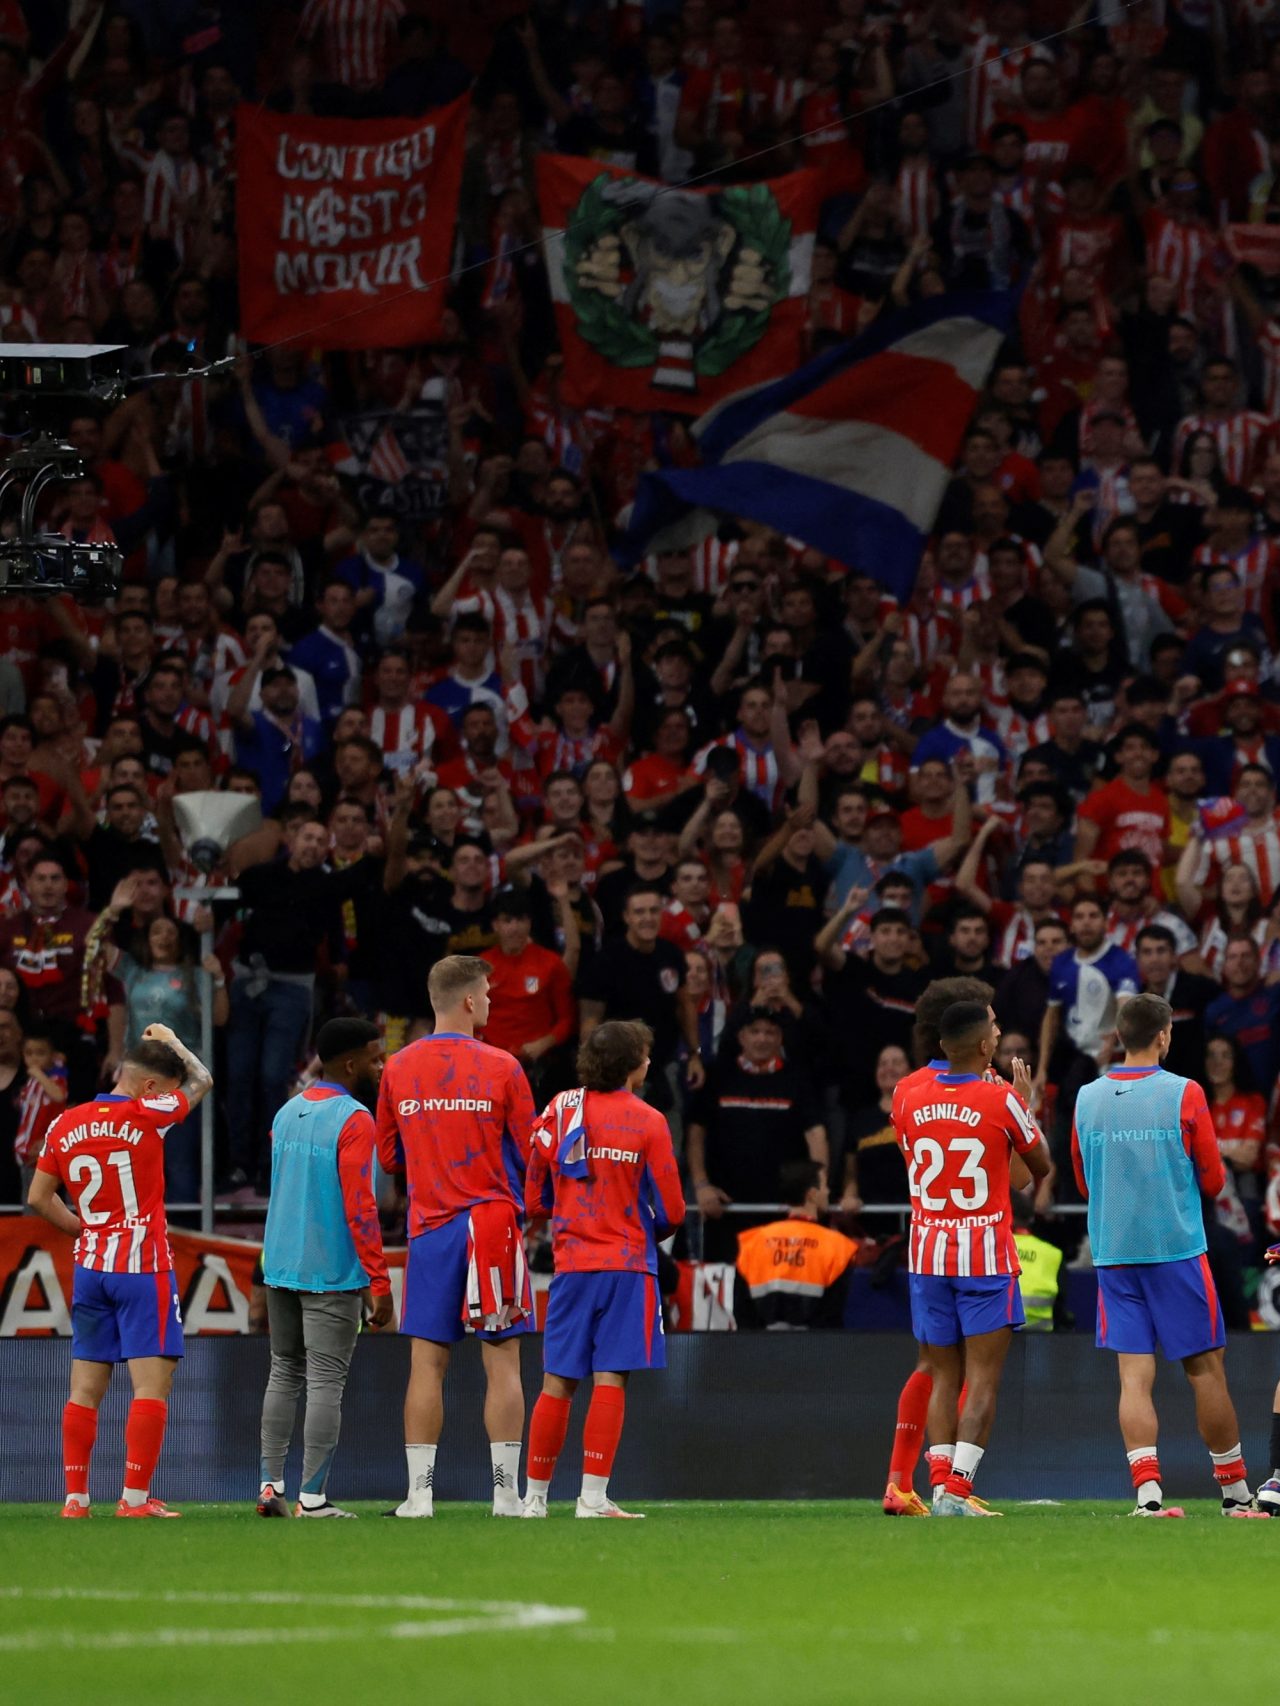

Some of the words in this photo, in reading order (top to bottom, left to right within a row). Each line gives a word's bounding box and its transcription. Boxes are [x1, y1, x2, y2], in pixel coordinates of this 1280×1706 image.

[276, 125, 436, 182] CONTIGO
[274, 236, 430, 296] MORIR
[424, 1099, 492, 1112] HYUNDAI
[912, 1103, 981, 1127] REINILDO
[59, 1124, 87, 1153] JAVI
[90, 1121, 144, 1146] GALÁN
[586, 1147, 639, 1163] YUNDAI
[68, 1150, 139, 1226] 21
[913, 1137, 989, 1211] 23
[934, 1211, 1003, 1229] HYUNDAI
